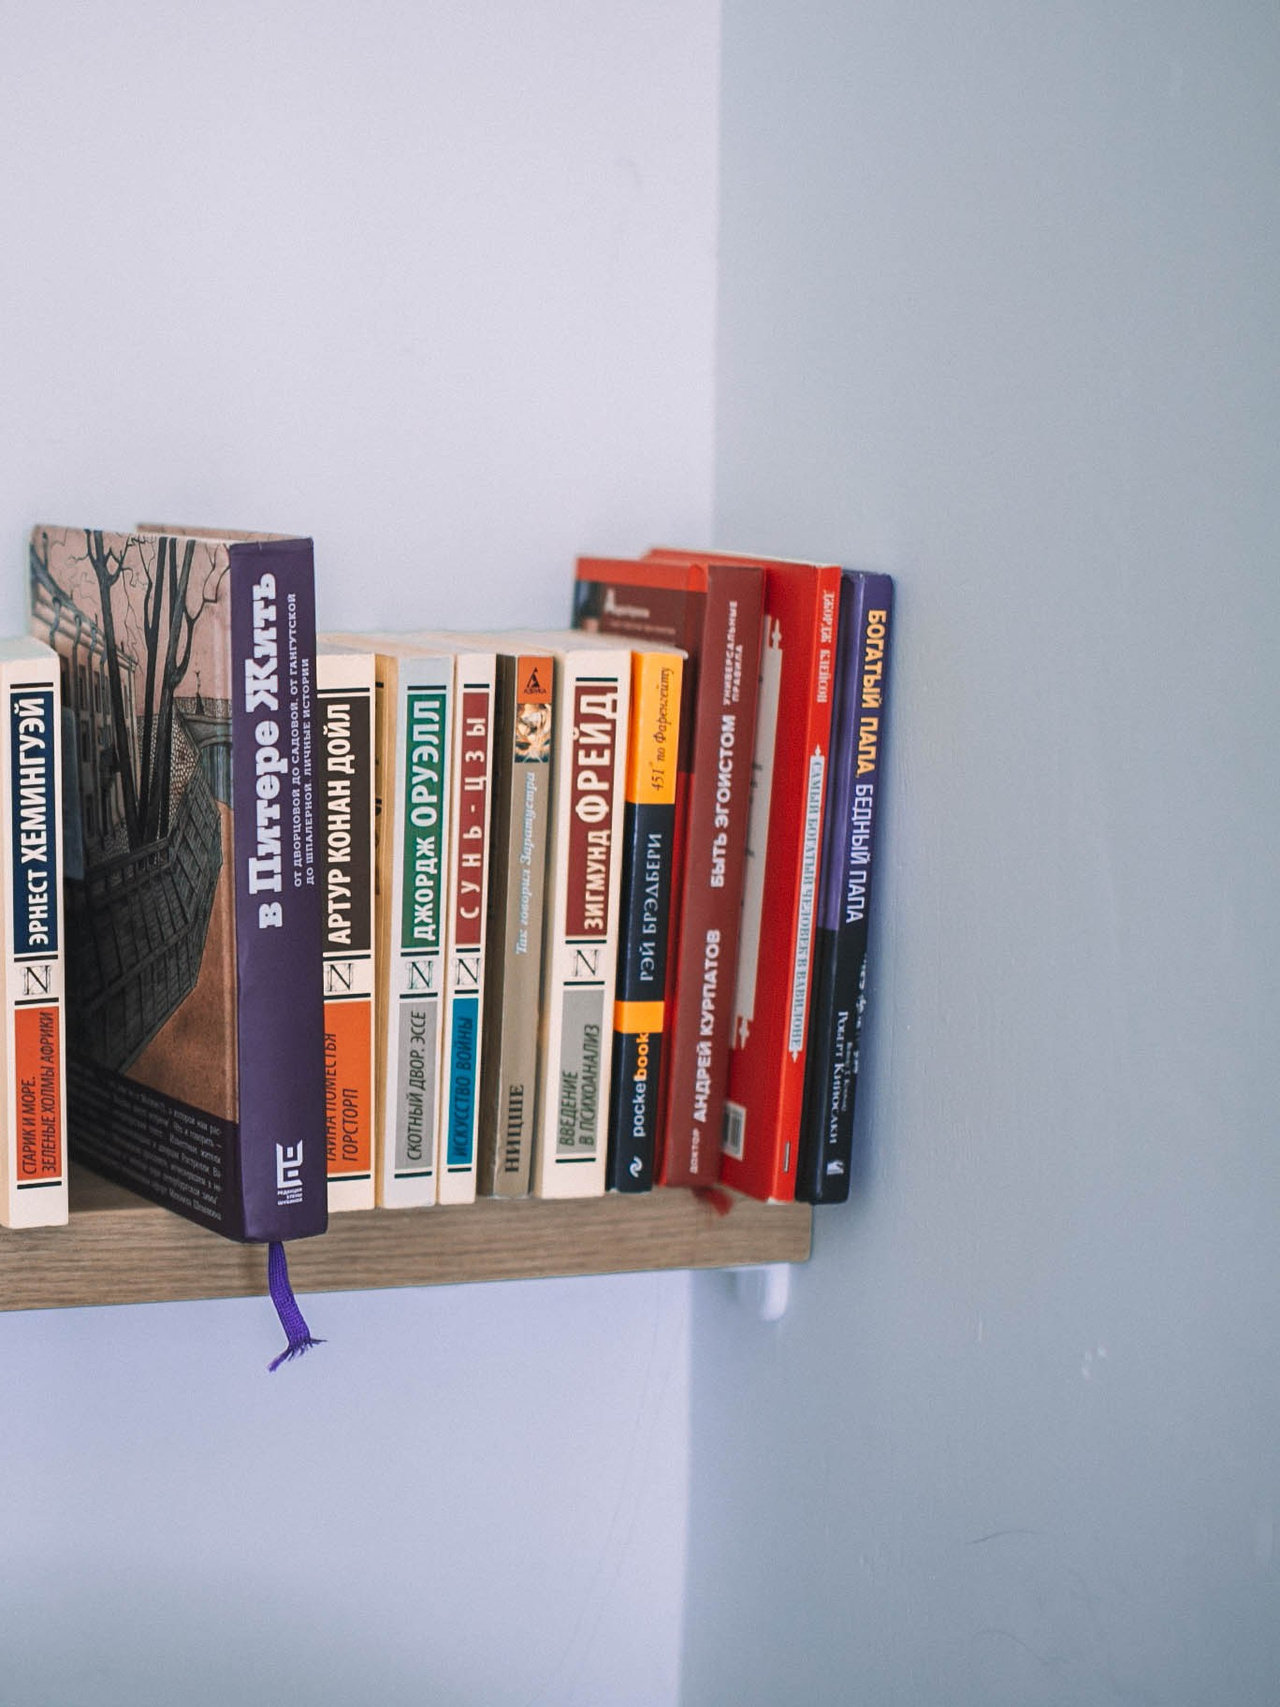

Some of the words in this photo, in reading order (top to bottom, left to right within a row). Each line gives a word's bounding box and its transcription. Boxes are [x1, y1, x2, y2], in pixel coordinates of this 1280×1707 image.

[245, 573, 279, 713] Жить
[287, 593, 298, 676] ГАНГУТСКОЙ
[723, 600, 737, 706] УНИВЕРСАЛЬНЫЕ
[861, 609, 886, 708] БОГАТЫЙ
[290, 677, 298, 695] ОТ
[302, 658, 311, 718] ИСТОРИИ
[652, 666, 674, 744] Фаренгейту
[731, 644, 743, 703] ПРАВИЛА
[303, 721, 312, 775] ЛИЧНЫЕ
[322, 704, 355, 774] ДОЙЛ
[410, 700, 440, 827] ОРУЭЛЛ
[572, 692, 617, 823] ФРЕЙД
[656, 747, 666, 762] по
[715, 715, 736, 827] ЭГОИСТОМ
[13, 698, 47, 865] ХЕМИНГУЭЙ
[249, 720, 288, 894] Питере
[292, 766, 301, 785] ДО
[809, 760, 822, 815] САМЫЙ
[292, 788, 302, 867] ДВОРЦОВОЙ
[327, 779, 351, 864] КОНАН
[520, 772, 537, 865] Заратустра
[803, 818, 818, 885] БОГАТЫЙ
[850, 784, 873, 864] БЕДНЫЙ
[294, 870, 302, 887] ОТ
[306, 867, 315, 886] ДО
[413, 836, 438, 941] ДЖОРДЖ
[583, 829, 612, 930] ЗИГМУНД
[642, 833, 662, 934] БРЭДБЕРИ
[710, 836, 728, 888] БЫТЬ
[27, 869, 48, 946] ЭРНЕСТ
[327, 868, 351, 944] АРТУР
[520, 869, 532, 926] говорил
[798, 889, 812, 956] ЧЕЛОВЕК
[846, 871, 867, 924] ПАПА
[515, 930, 528, 955] Так
[640, 942, 655, 981] РЭЙ
[700, 929, 721, 1037] КУРПАТОВ
[791, 970, 805, 1047] ВАВИЛОНЕ
[39, 1012, 55, 1063] АФРИКИ
[410, 1010, 426, 1045] ЭССЕ
[456, 1017, 473, 1070] ВОЙНЫ
[21, 1076, 36, 1115] МОРЕ.
[40, 1066, 56, 1113] ХОЛМЫ
[409, 1048, 426, 1091] ДВОР.
[580, 1023, 600, 1132] ПСИХОАНАЛИЗ
[693, 1043, 713, 1123] АНДРЕЙ
[21, 1117, 36, 1127] И
[341, 1088, 358, 1162] ГОРСТОРП
[406, 1093, 424, 1161] СКОТНЫЙ
[452, 1076, 471, 1157] ИСКУССТВО
[504, 1084, 524, 1173] НИЦШЕ
[559, 1070, 578, 1147] ВВЕДЕНИЕ
[579, 1132, 595, 1146] В
[21, 1128, 37, 1175] СТАРИК
[41, 1115, 56, 1172] ЗЕЛЕНЫЕ
[689, 1128, 701, 1174] ДОКТОР
